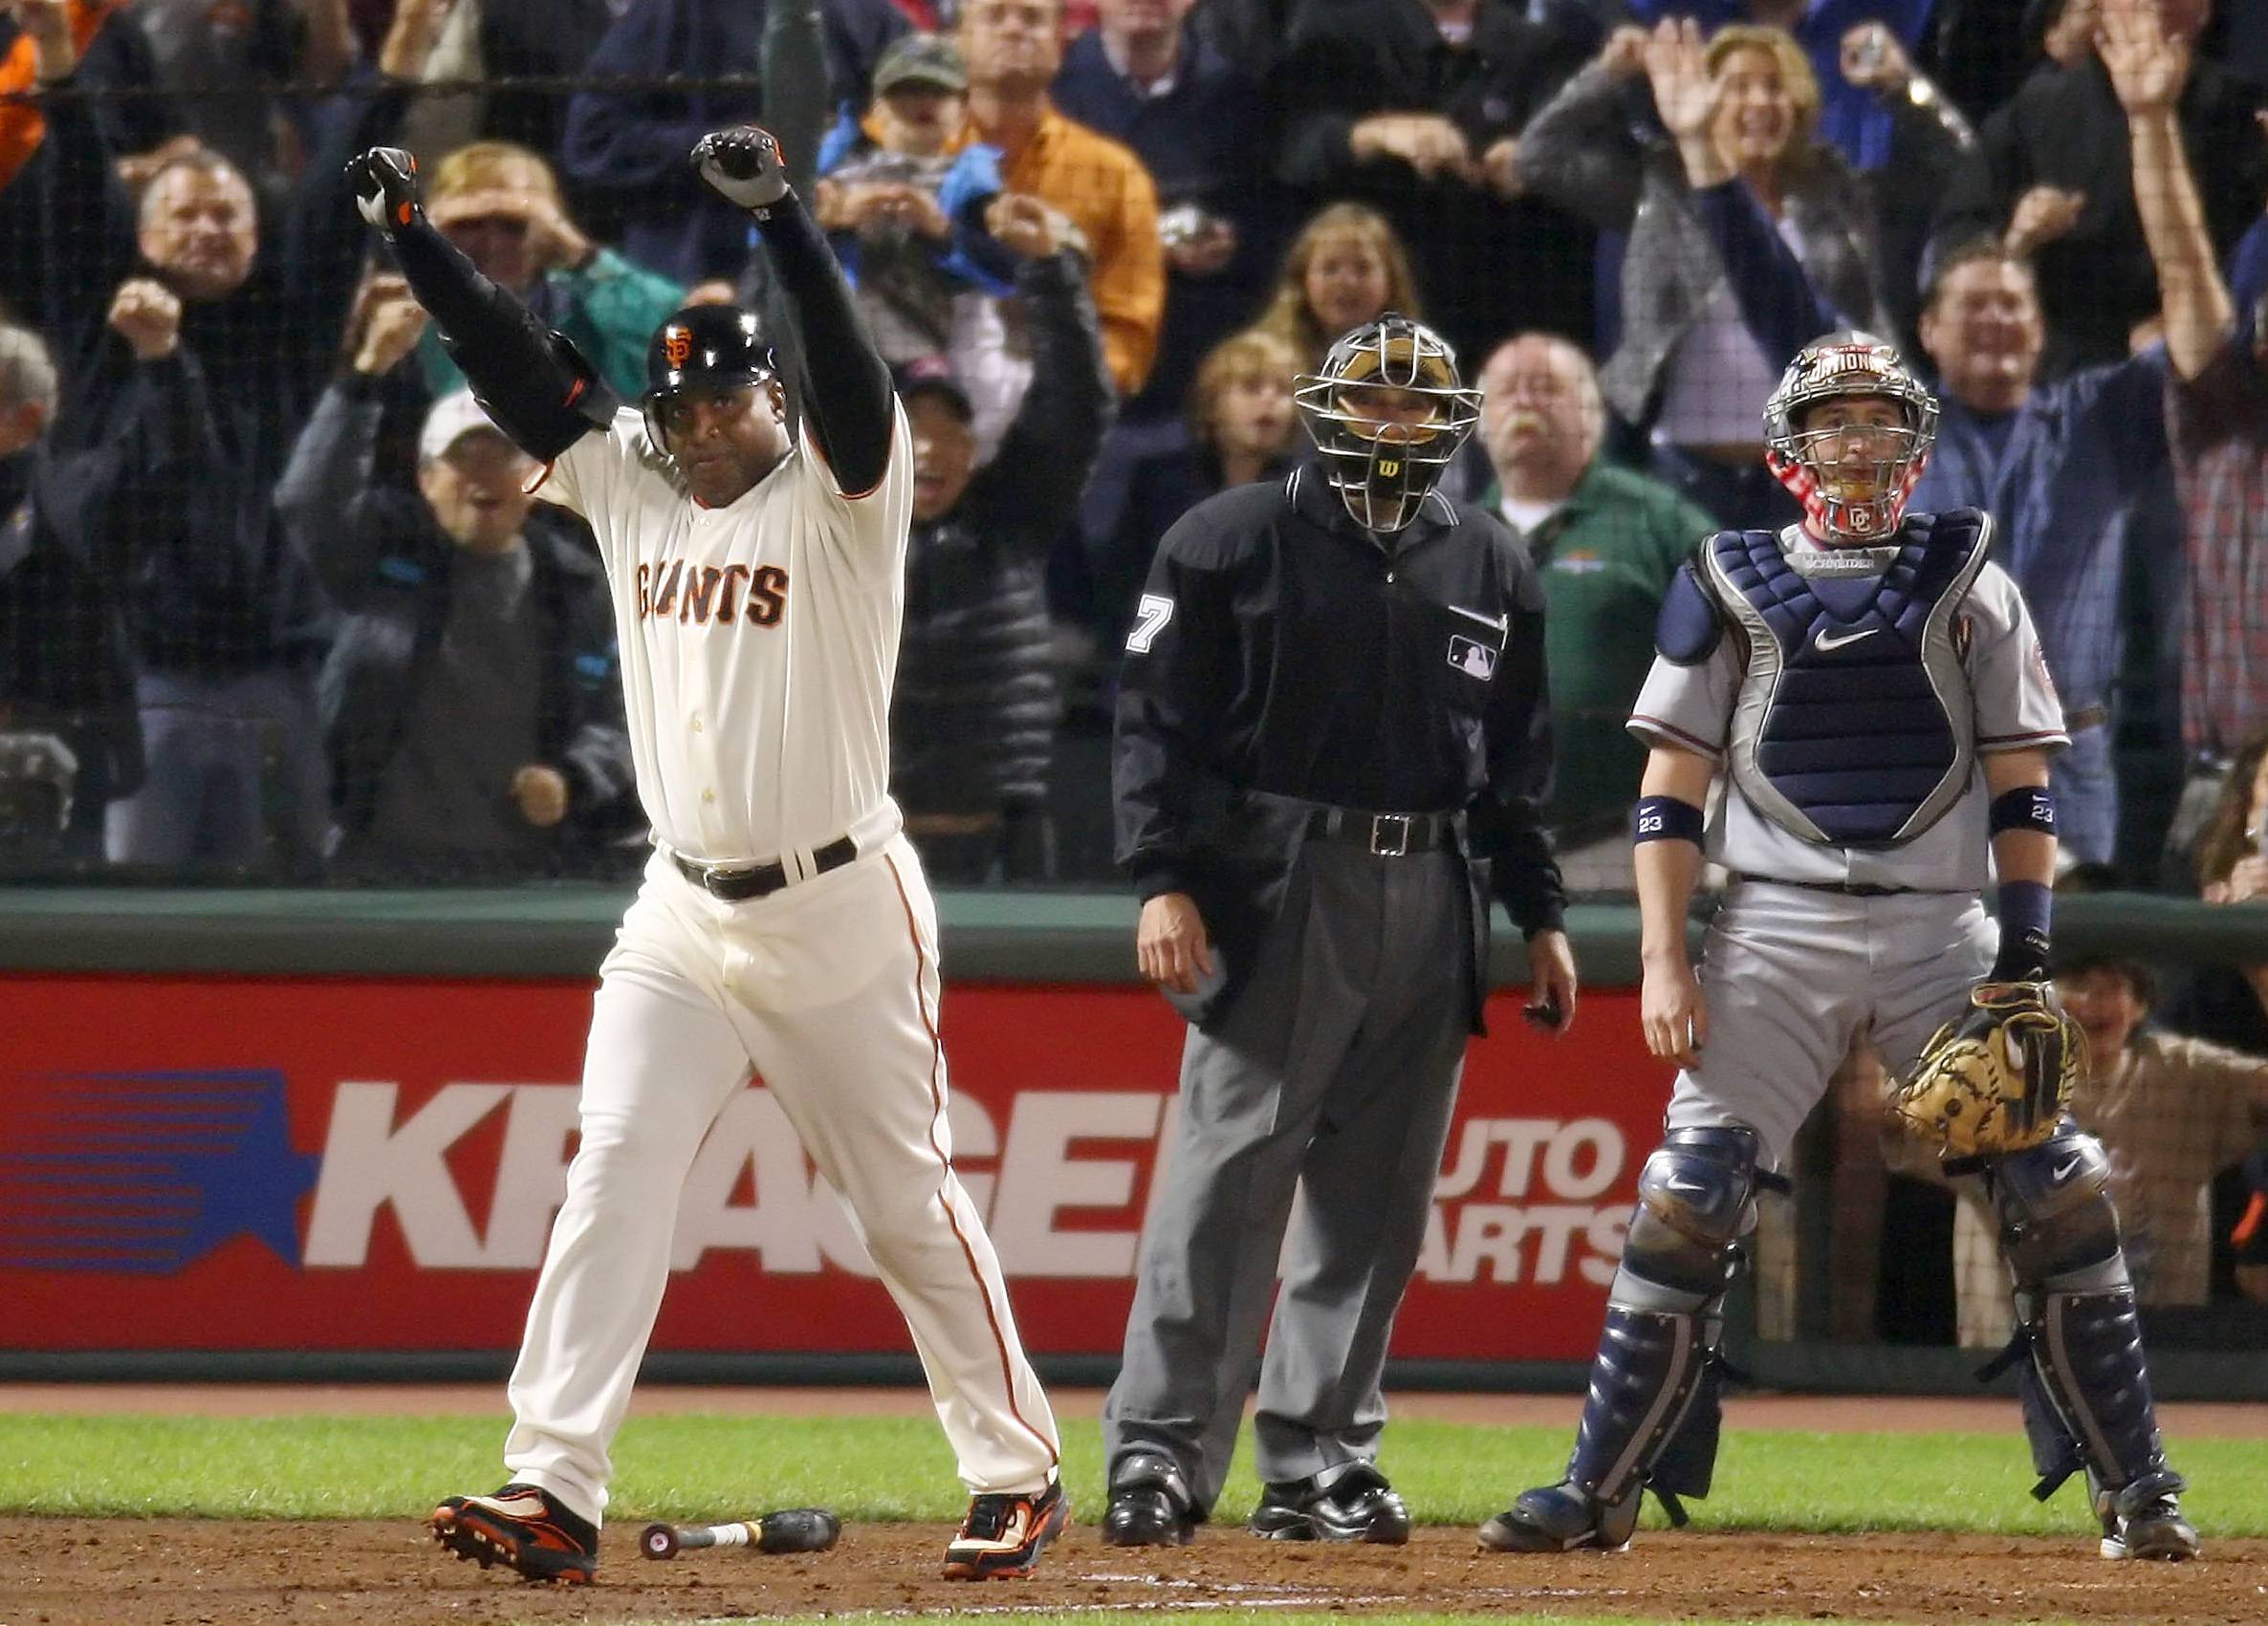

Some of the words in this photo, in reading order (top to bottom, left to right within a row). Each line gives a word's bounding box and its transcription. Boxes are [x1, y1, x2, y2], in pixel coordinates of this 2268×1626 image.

[1125, 594, 1174, 653] 7
[1639, 815, 1662, 833] 23
[2031, 805, 2054, 822] 23
[303, 1081, 1181, 1278] KRAE
[1433, 1117, 1625, 1200] UTO
[1416, 1203, 1635, 1286] ARTS
